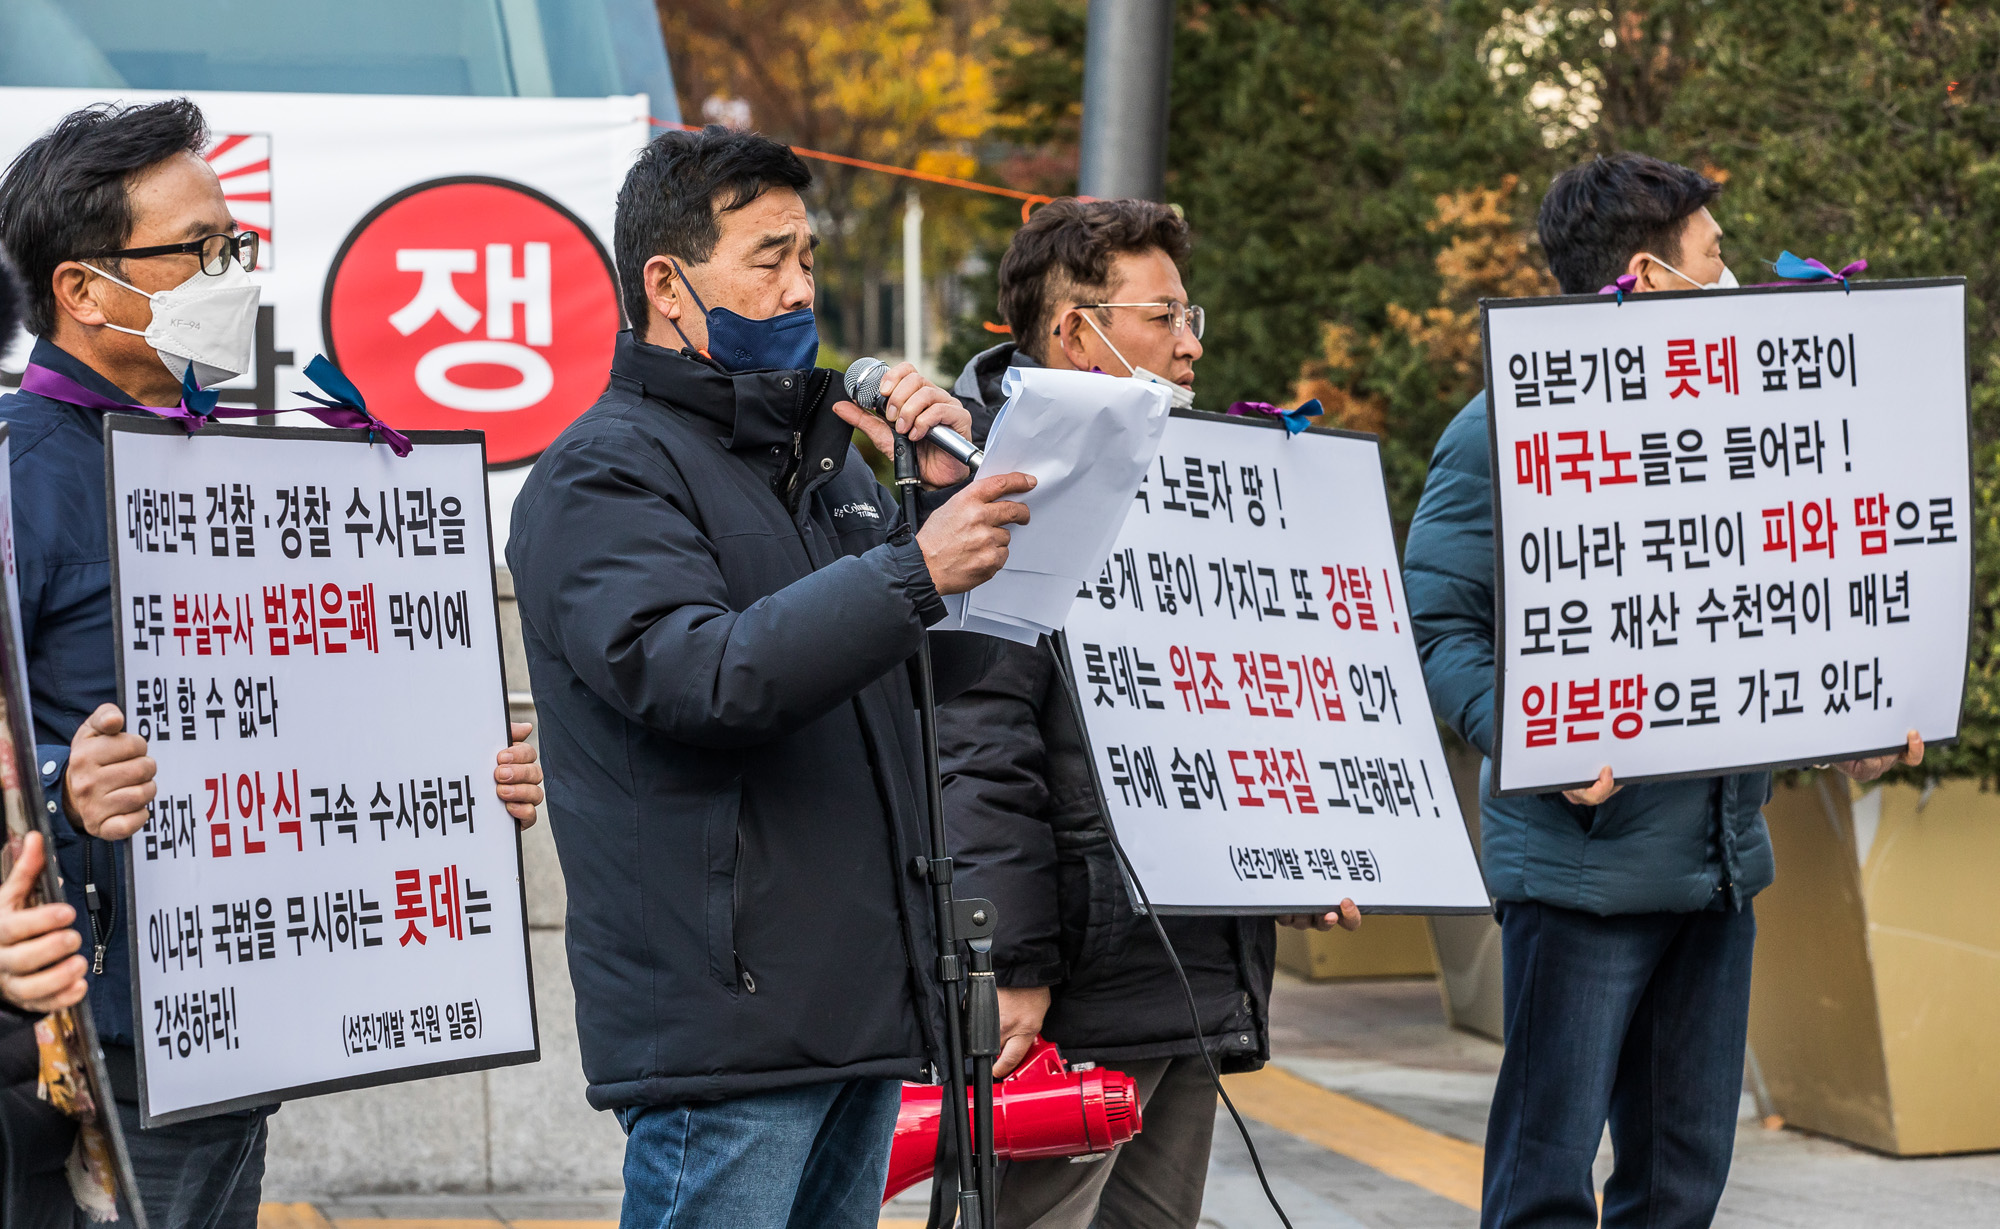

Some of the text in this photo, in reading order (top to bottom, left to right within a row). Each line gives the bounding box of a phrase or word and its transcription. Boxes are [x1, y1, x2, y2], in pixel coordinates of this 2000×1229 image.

[169, 318, 201, 330] KF-94
[388, 242, 554, 413] 쟁
[1509, 334, 1856, 407] 일본기업 롯데 앞잡이
[1160, 456, 1233, 523] 노른자
[1240, 465, 1265, 526] 땅
[1515, 429, 1707, 496] 매국노들은
[1724, 421, 1825, 480] 들어라
[127, 489, 196, 555] 대한민국
[345, 487, 465, 558] 수사관을
[1521, 493, 1957, 582] 이나라 국민이 피와 땀으로
[133, 583, 471, 656] 모두 부실수사 범죄은폐 막이에
[1148, 552, 1203, 616] 많이
[1209, 558, 1285, 621] 가지고
[1290, 569, 1319, 620] 또
[1521, 571, 1909, 655] 모은 재산 수천억이 매년
[136, 676, 278, 743] 동원 할 수 없다
[1083, 643, 1401, 724] 롯데는 위조 전문기업 인가
[1522, 657, 1892, 748] 일본땅으로 가고 있다.
[310, 784, 357, 846] 구속
[370, 775, 475, 841] 수사하라
[1107, 744, 1167, 809] 뒤에
[1171, 747, 1227, 811] 숨어
[1228, 748, 1319, 813] 도적질
[1319, 757, 1420, 817] 그만해라
[1230, 846, 1381, 882] (선진개발 직원 일동)
[150, 865, 491, 973] 이나라 국법을 무시하는 롯데는
[154, 987, 239, 1060] 각성하라!
[343, 999, 482, 1057] (선진개발 직원 일동)
